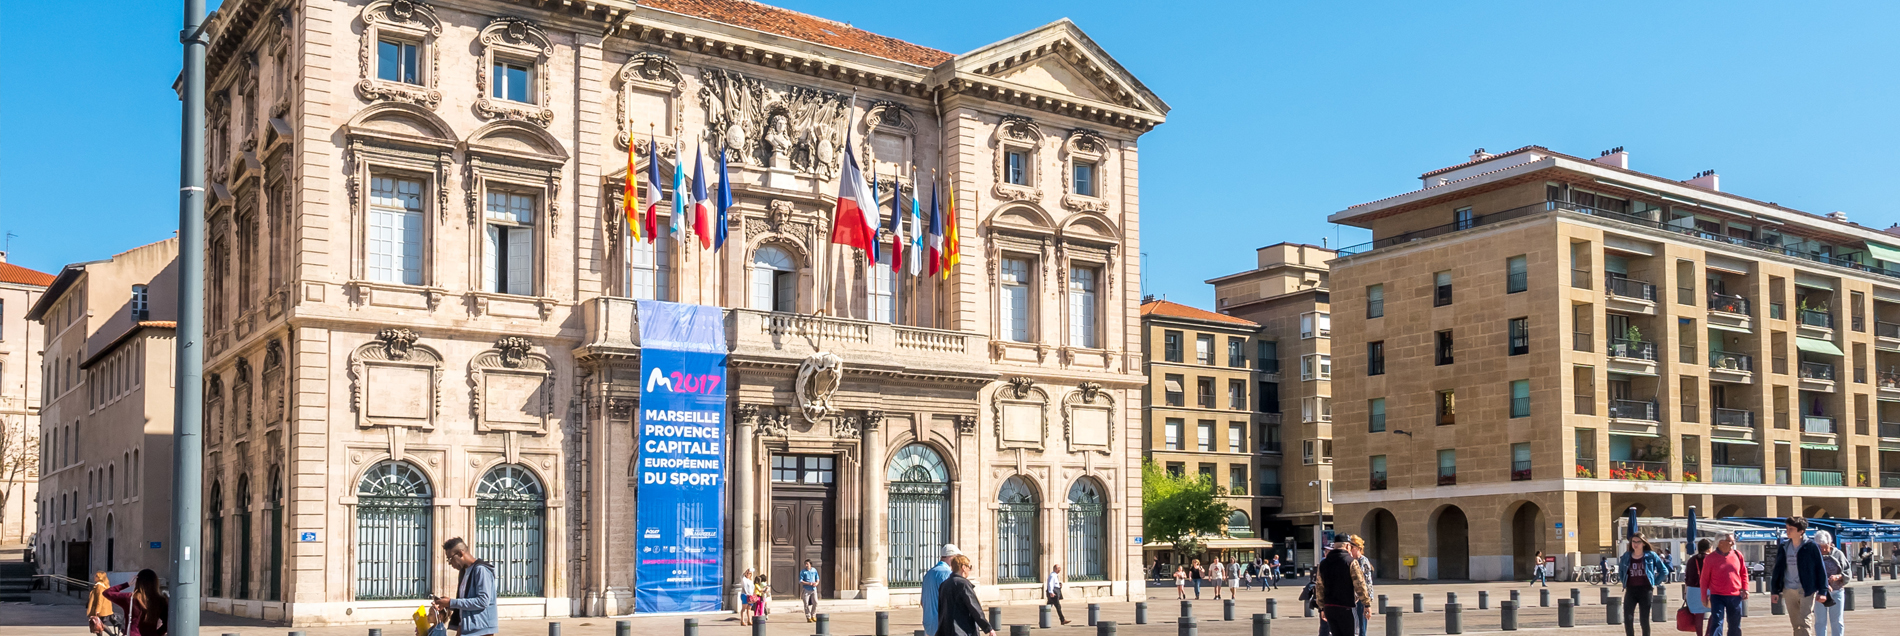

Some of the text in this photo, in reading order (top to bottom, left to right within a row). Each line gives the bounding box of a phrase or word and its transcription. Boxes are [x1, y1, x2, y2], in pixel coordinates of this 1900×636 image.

[645, 409, 720, 424] MARSEILLE
[645, 424, 720, 439] PROVENCE
[645, 440, 719, 455] CAPITALE
[644, 457, 719, 469] EUROPÉENNE
[644, 471, 719, 486] DU SPORT
